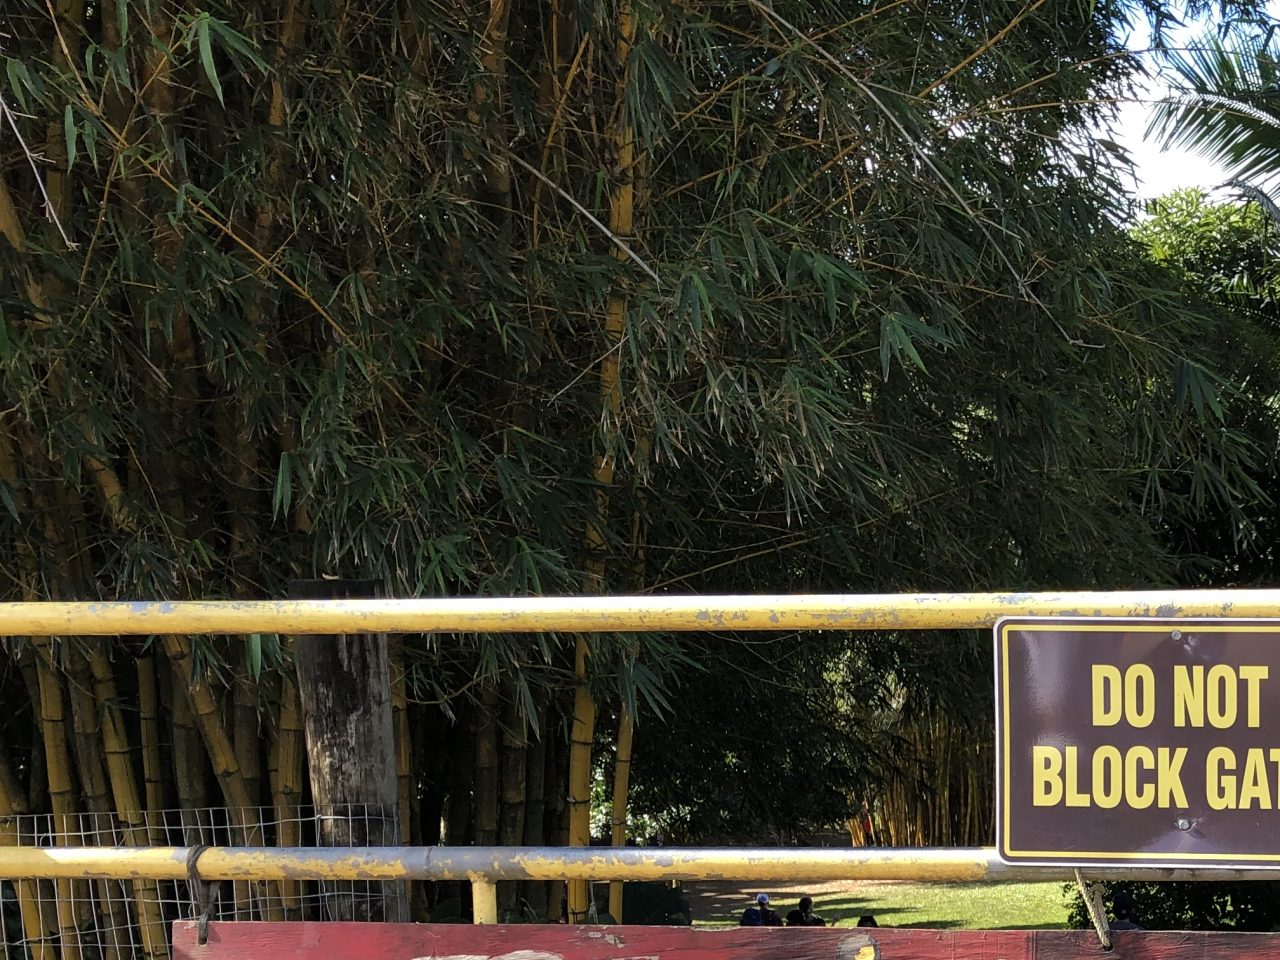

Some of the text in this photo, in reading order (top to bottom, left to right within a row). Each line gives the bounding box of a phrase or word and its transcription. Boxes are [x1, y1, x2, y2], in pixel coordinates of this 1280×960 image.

[1092, 663, 1269, 728] DO NOT
[1032, 745, 1189, 809] BLOCK
